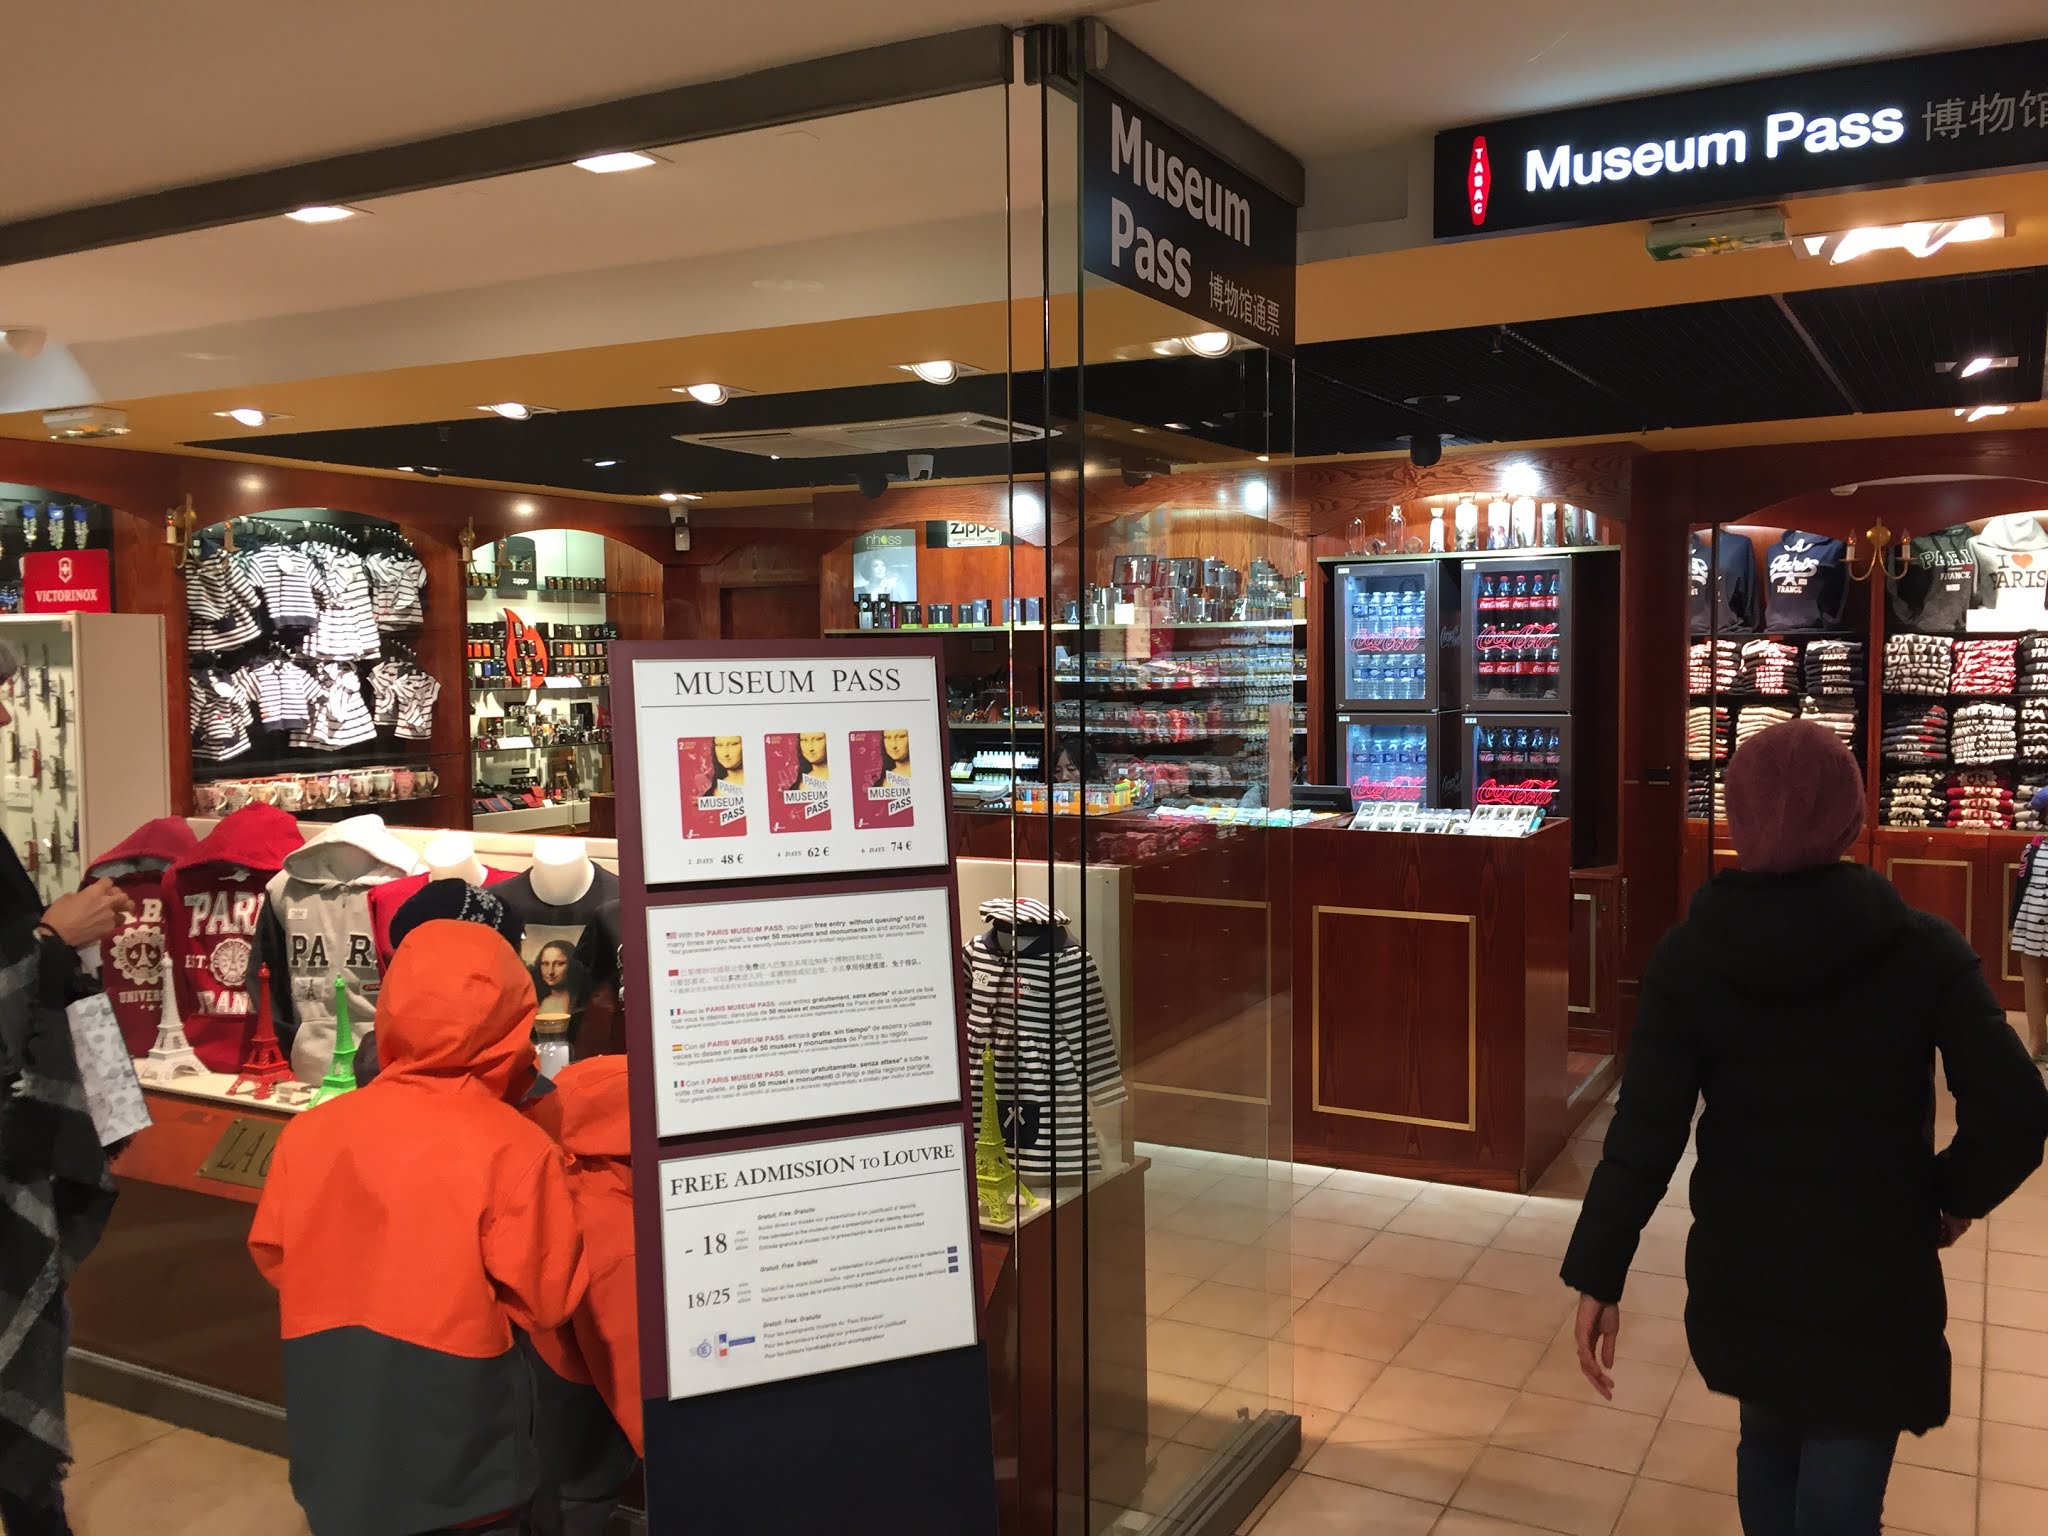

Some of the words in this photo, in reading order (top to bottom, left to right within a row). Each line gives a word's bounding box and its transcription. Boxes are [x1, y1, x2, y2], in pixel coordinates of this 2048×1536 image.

[1525, 127, 1747, 193] Museum
[1766, 106, 1905, 159] Pass
[1112, 103, 1250, 247] Museum
[1474, 148, 1484, 214] TABAC
[1112, 197, 1192, 298] Pass
[1208, 271, 1280, 336] 博物馆通票
[1920, 549, 1974, 569] PARI
[1940, 571, 1971, 581] FRANCE
[1989, 570, 2047, 590] PARIS
[35, 588, 98, 603] VICTORINOX
[1776, 585, 1803, 594] FRANCE
[674, 669, 815, 696] MUSEUM
[832, 668, 902, 693] PASS
[804, 774, 827, 789] PARIS
[887, 771, 910, 787] PARIS
[718, 780, 743, 796] PARIS
[785, 790, 828, 801] MUSEUM
[869, 786, 911, 798] MUSEUM
[699, 796, 744, 808] MUSEUM
[805, 799, 829, 816] PASS
[889, 796, 912, 812] PASS
[721, 805, 745, 822] PASS
[807, 847, 820, 857] 62
[822, 846, 830, 856] €
[890, 841, 902, 851] 74
[905, 840, 912, 850] €
[720, 854, 734, 864] 48
[736, 853, 743, 864] €
[184, 891, 265, 937] PARI
[706, 928, 728, 936] PARIS
[730, 926, 762, 935] MUSEUM
[814, 921, 827, 929] free
[848, 918, 873, 926] without
[754, 933, 769, 941] over
[781, 929, 813, 939] museums
[815, 928, 828, 936] and
[829, 925, 867, 935] monuments
[118, 990, 164, 1004] UNIVER
[705, 1005, 725, 1013] PARIS
[726, 1002, 756, 1011] MUSEUM
[809, 1001, 844, 1011] monuments
[707, 1039, 729, 1048] PARIS
[730, 1036, 763, 1046] MUSEUM
[833, 1027, 844, 1035] sin
[749, 1045, 758, 1053] de
[769, 1041, 796, 1050] museos
[803, 1036, 846, 1047] monumentos
[706, 1075, 729, 1085] PARIS
[730, 1072, 762, 1082] MUSEUM
[859, 1059, 879, 1068] senza
[757, 1080, 766, 1088] 50
[669, 1171, 728, 1196] FREE
[732, 1154, 855, 1187] ADMISSION
[859, 1155, 880, 1170] TO
[882, 1142, 954, 1166] LOUVRE
[702, 1231, 727, 1256] 18
[687, 1288, 731, 1309] 18/25
